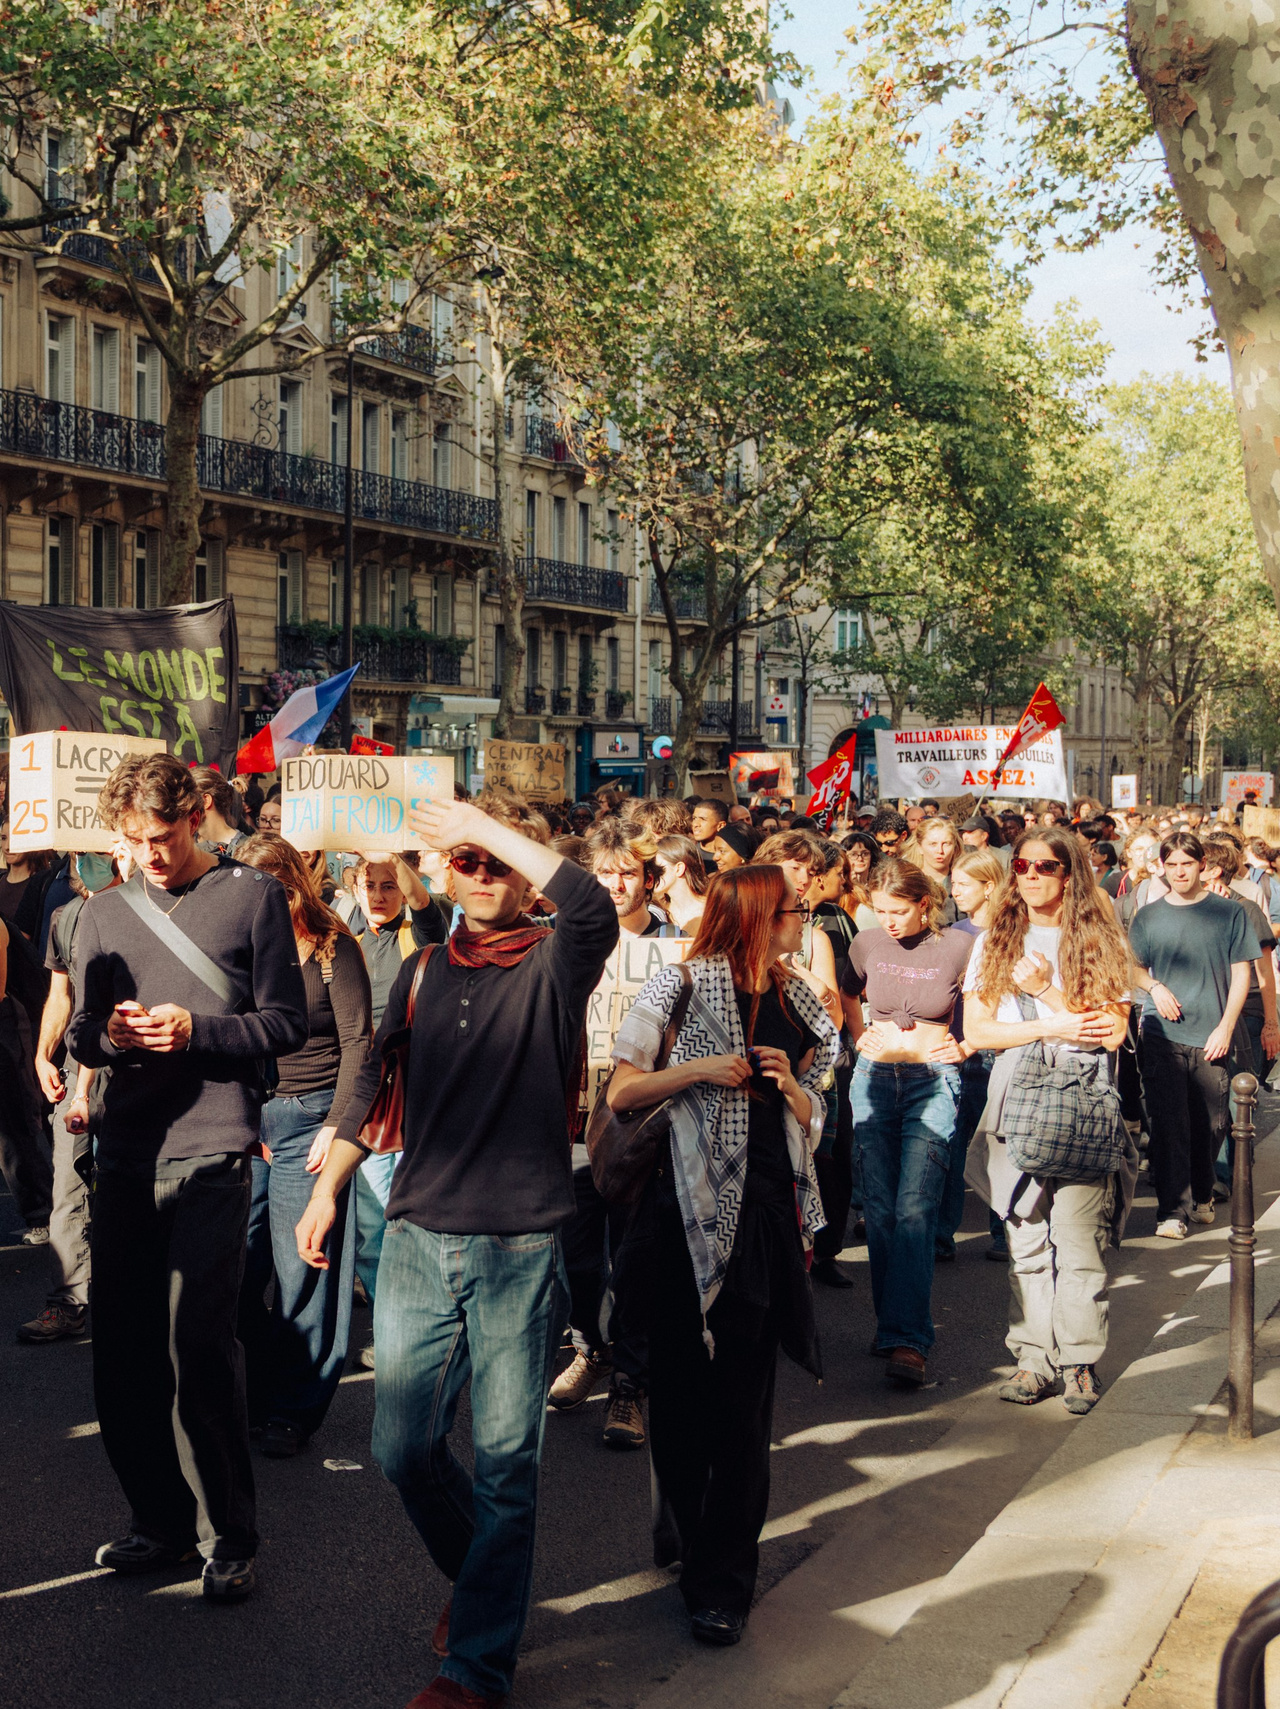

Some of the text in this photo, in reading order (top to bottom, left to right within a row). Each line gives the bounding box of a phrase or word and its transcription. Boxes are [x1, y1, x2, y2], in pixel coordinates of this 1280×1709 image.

[46, 638, 227, 704] LE MONDE
[99, 695, 164, 739] EST
[894, 728, 988, 744] MILLIARDAIRES
[20, 737, 132, 773] 1 LACRY
[897, 748, 987, 763] TRAVAILLEURS
[286, 758, 390, 792] EDOUARD
[12, 799, 104, 835] 25 REPA
